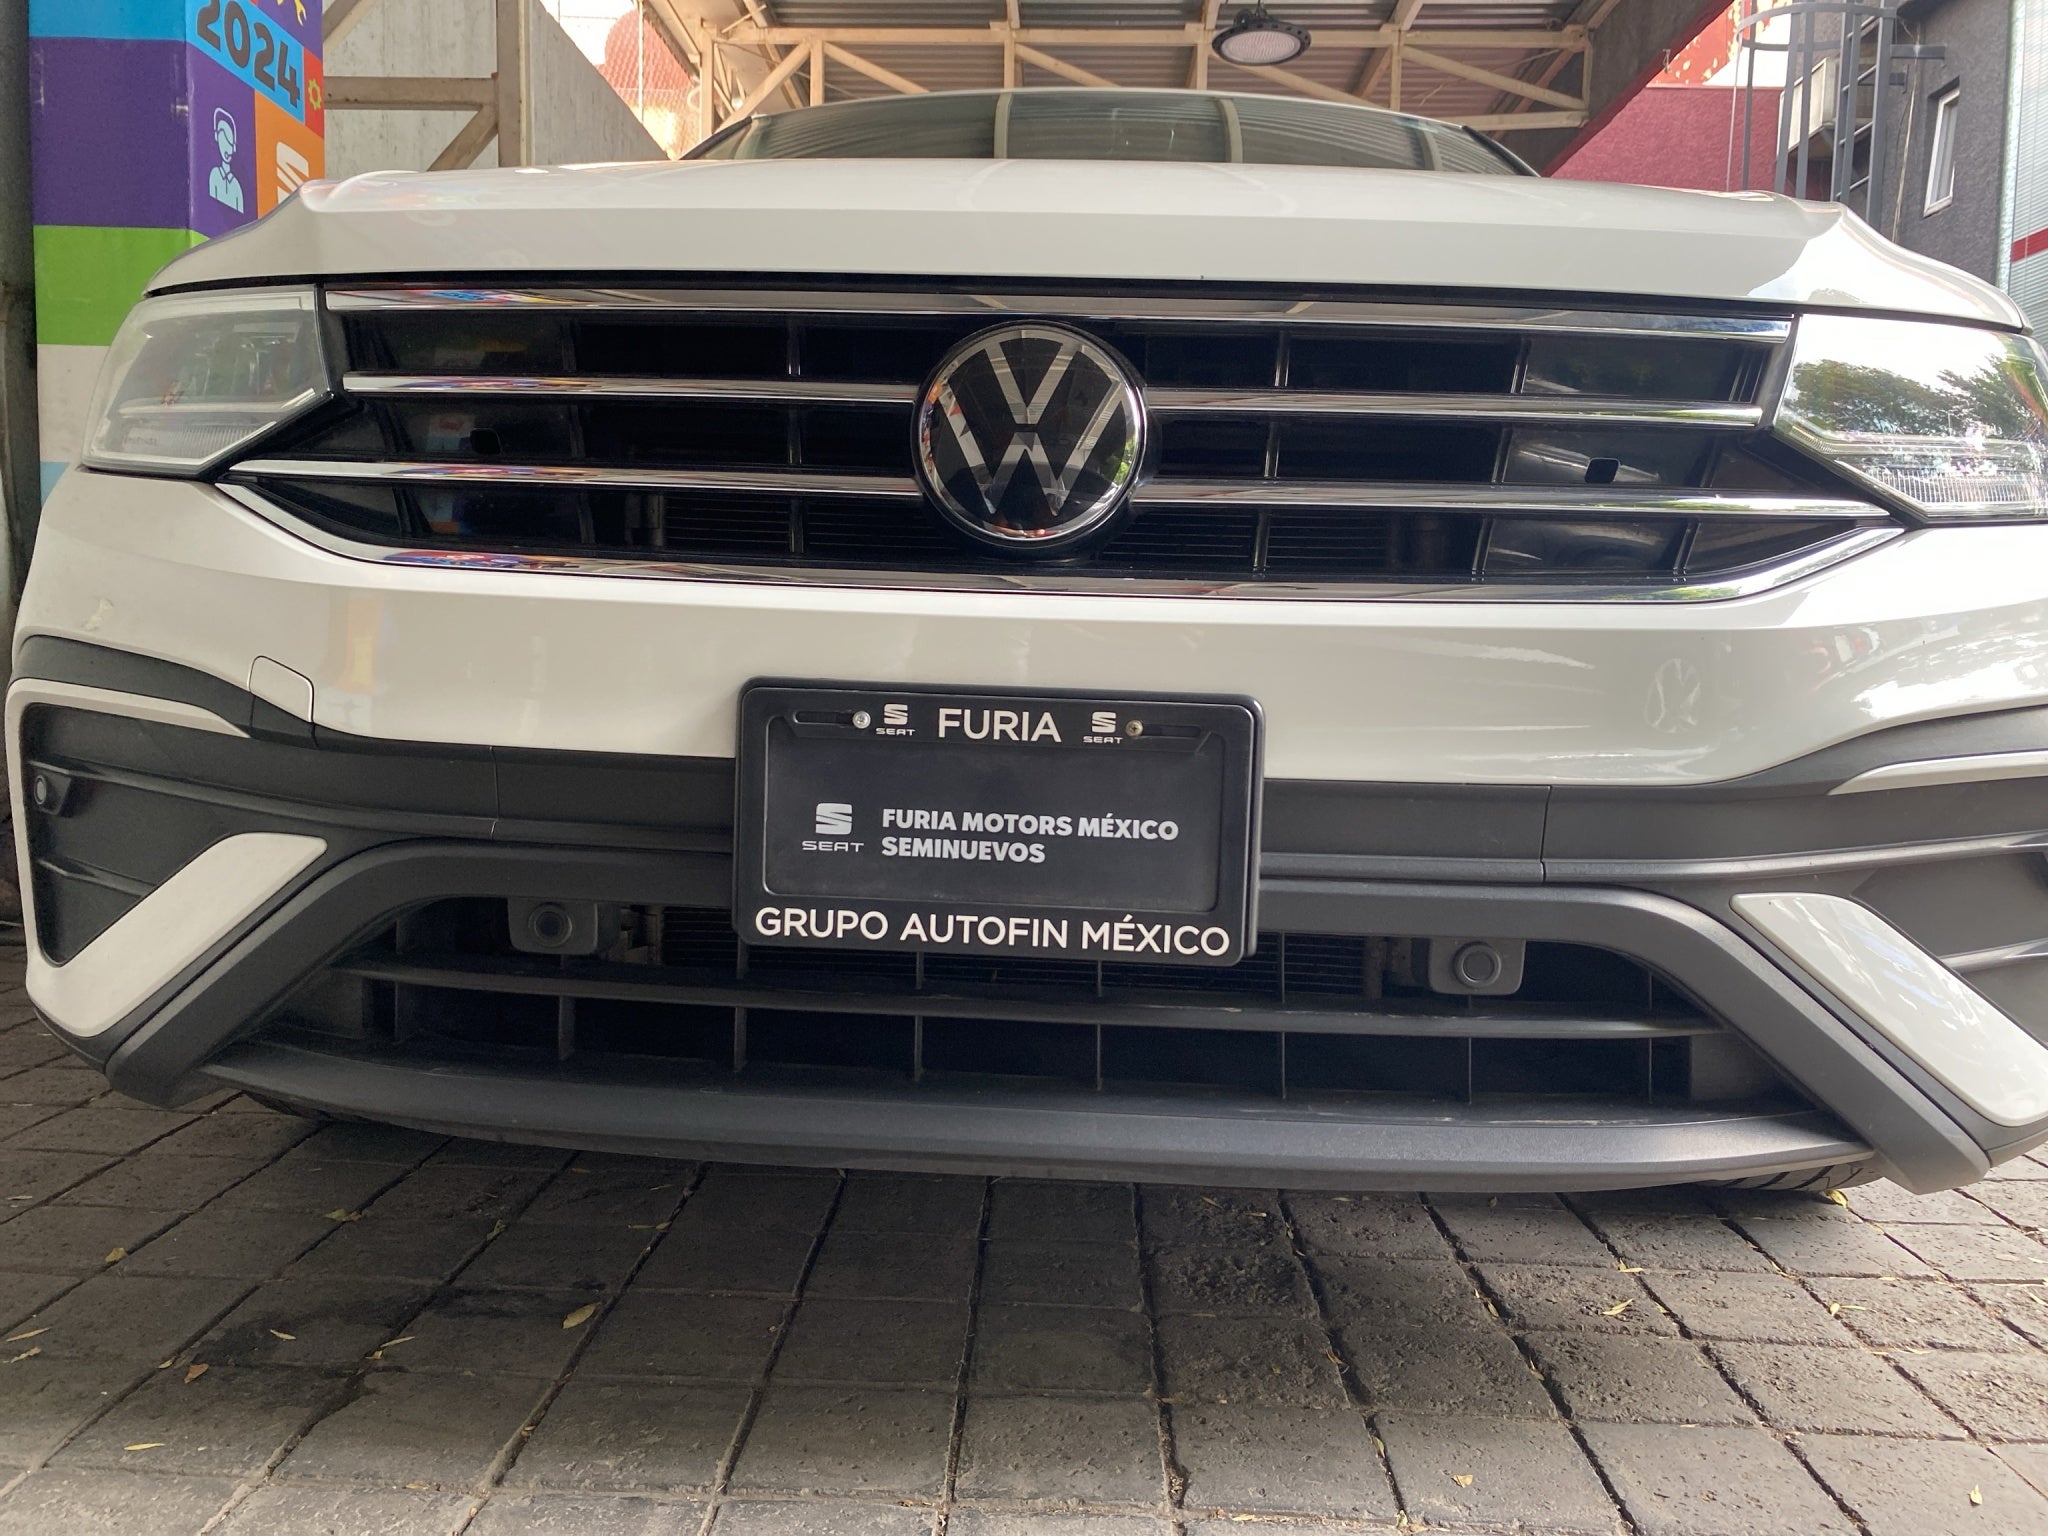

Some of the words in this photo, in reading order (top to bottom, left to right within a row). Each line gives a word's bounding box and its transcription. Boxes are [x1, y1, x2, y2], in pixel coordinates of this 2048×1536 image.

[197, 0, 300, 108] 2024
[875, 727, 916, 736] SEAT
[938, 707, 1062, 743] FURIA
[1083, 735, 1123, 744] SEAT
[882, 808, 957, 831] FURIA
[962, 812, 1073, 838] MOTORS
[1078, 812, 1179, 841] MÉXICO
[801, 840, 865, 853] SEAT
[881, 836, 1046, 864] SEMINUEVOS
[755, 906, 889, 940] GRUPO
[899, 912, 1068, 949] AUTOFIN
[1081, 913, 1230, 957] MÉXICO
